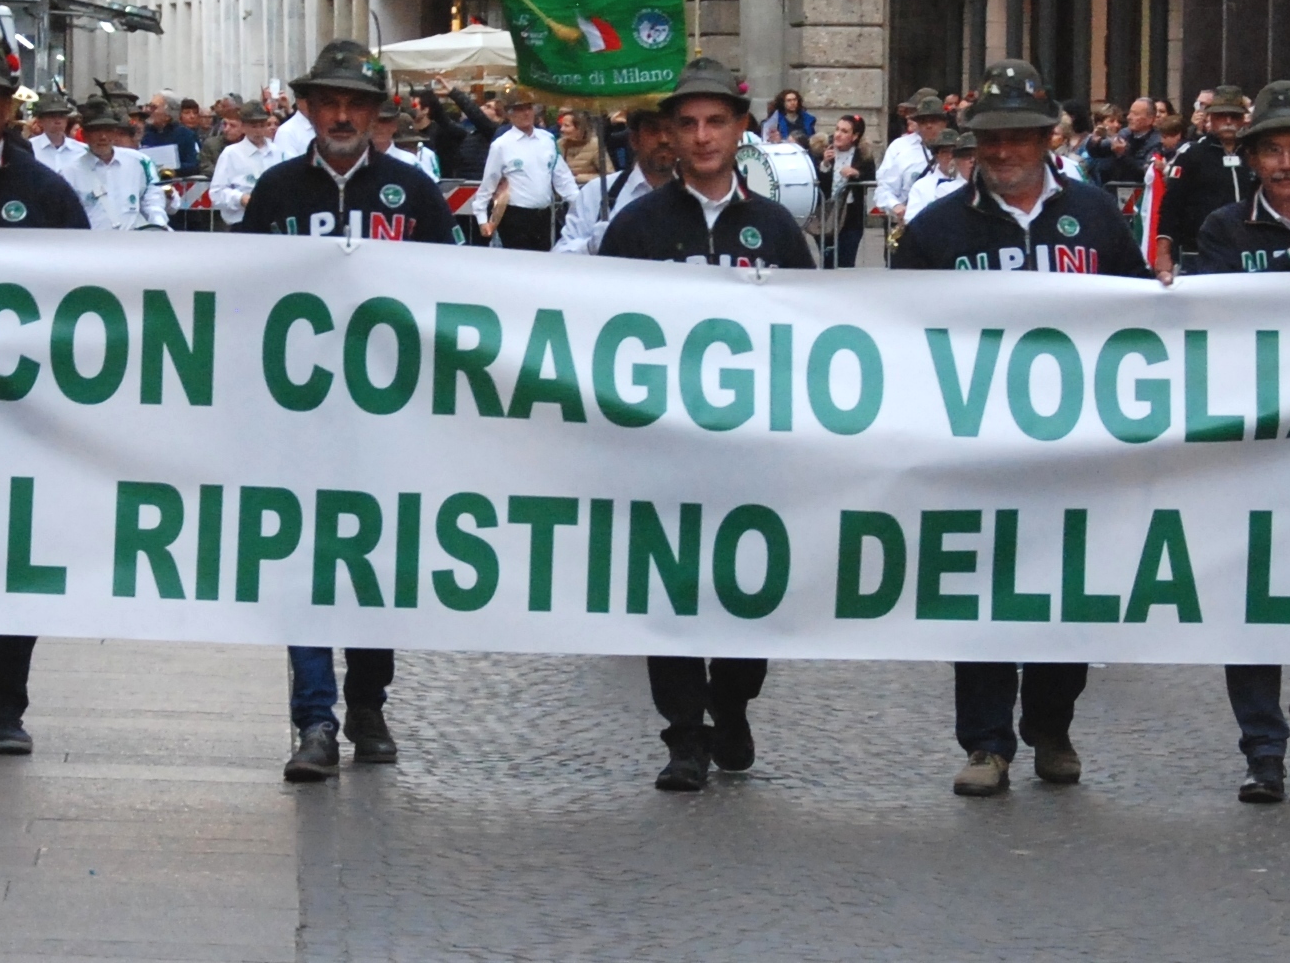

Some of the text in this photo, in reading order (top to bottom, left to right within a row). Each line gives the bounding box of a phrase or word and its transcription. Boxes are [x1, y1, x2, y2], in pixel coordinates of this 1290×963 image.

[589, 70, 605, 85] di
[613, 68, 674, 85] Milano
[262, 291, 884, 436] CORAGGIO
[112, 480, 791, 619] RIPRISTINO
[834, 508, 1203, 624] DELLA
